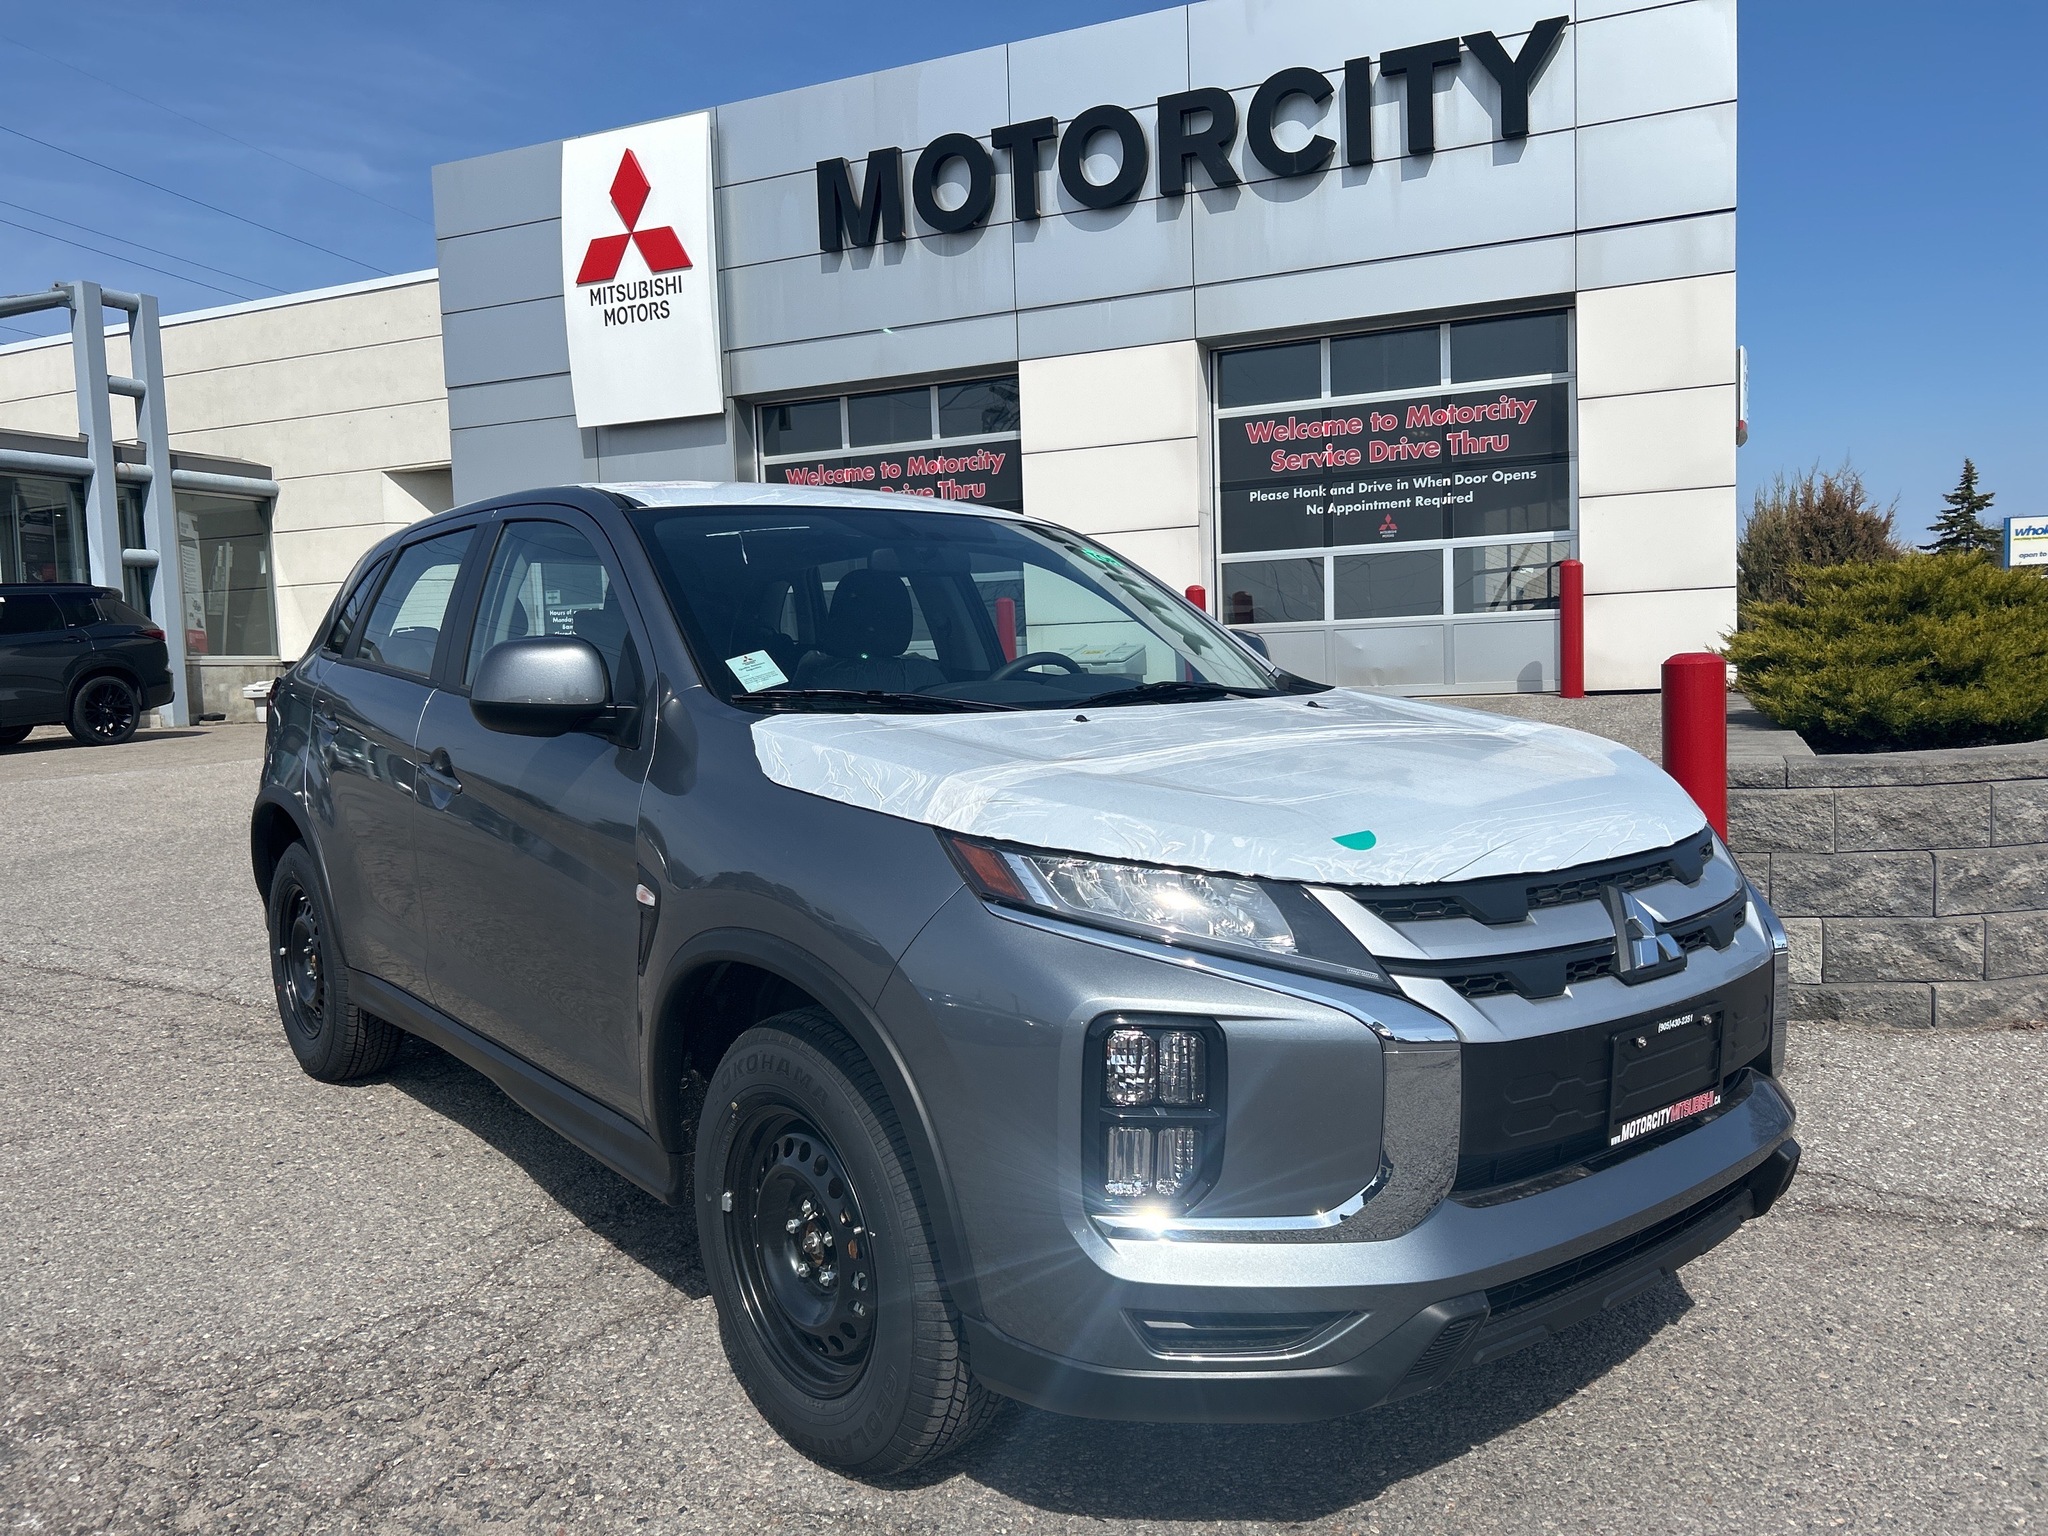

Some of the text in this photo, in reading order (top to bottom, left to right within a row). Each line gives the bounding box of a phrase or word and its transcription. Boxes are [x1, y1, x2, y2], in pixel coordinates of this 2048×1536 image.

[816, 15, 1569, 253] MOTORCITY
[589, 275, 683, 307] MITSUBISHI
[603, 300, 671, 327] MOTORS
[1245, 394, 1537, 444] Welcome to Motorcity
[785, 448, 1006, 486] Welcome to Motorcity
[1271, 430, 1509, 472] Service Drive Thru
[880, 479, 986, 501] ive Thru
[1249, 470, 1537, 502] Please Honk and Drive in When Door Opens
[1306, 491, 1474, 516] No Appointment Required
